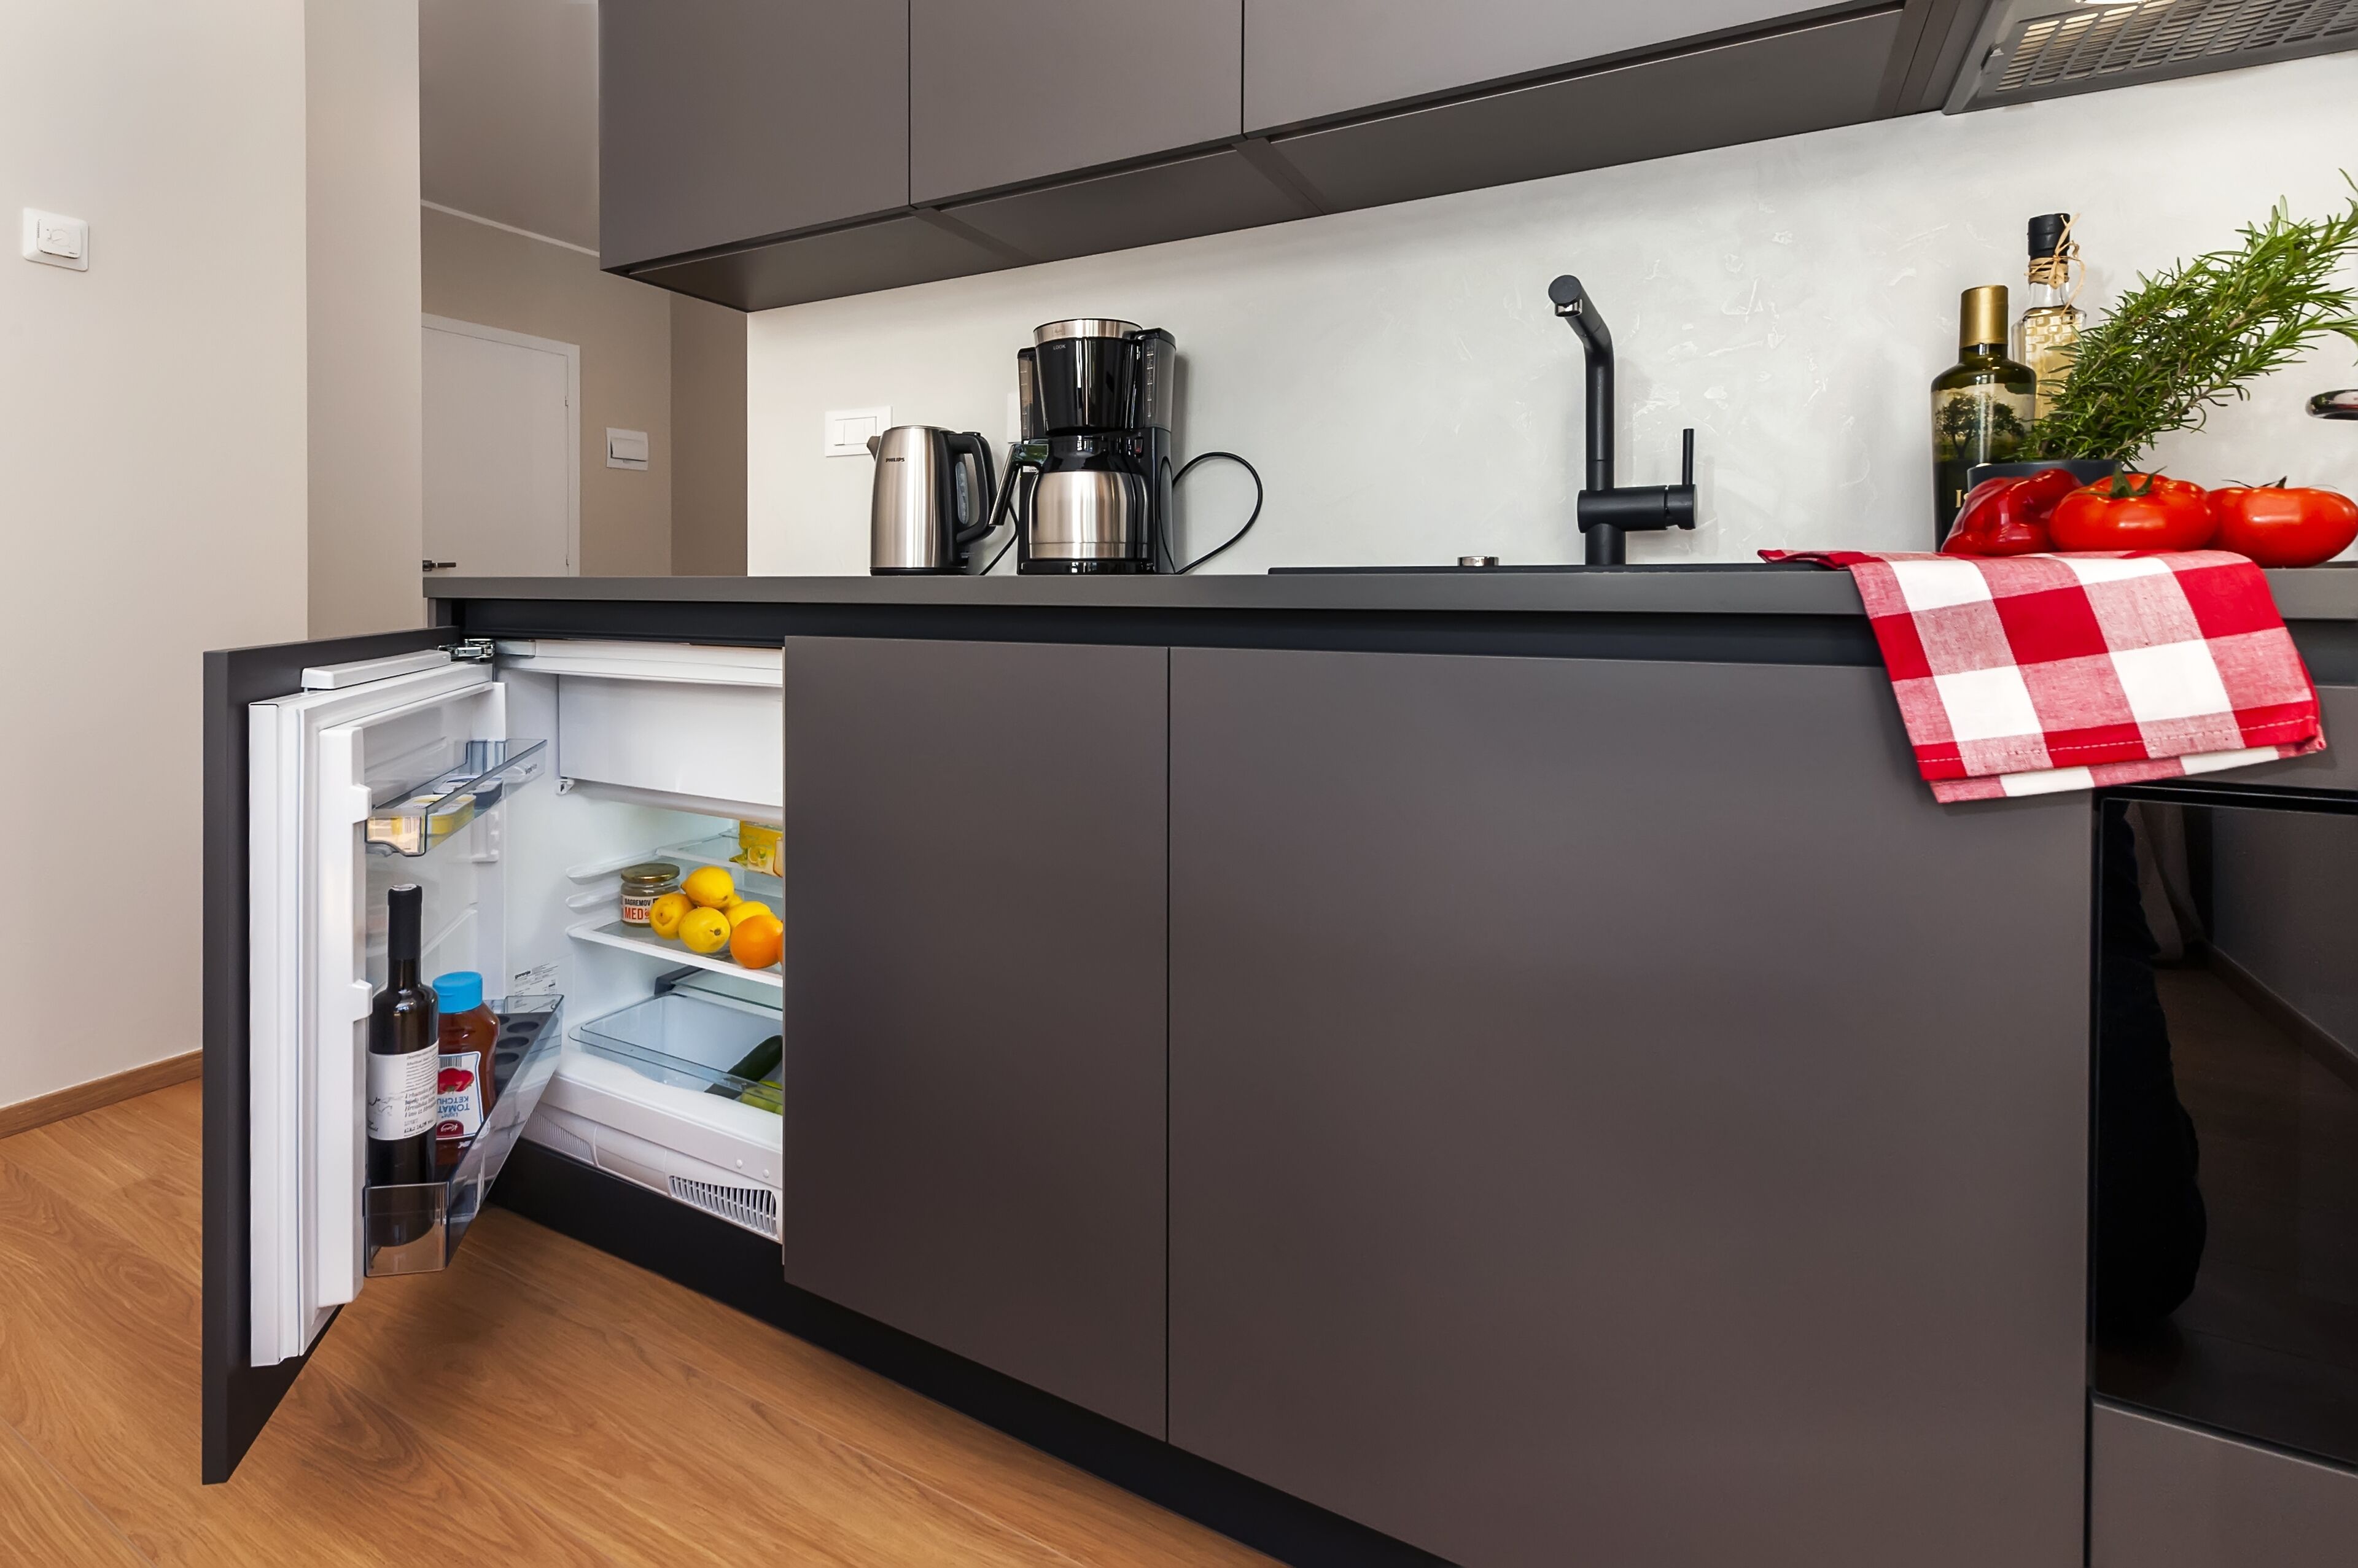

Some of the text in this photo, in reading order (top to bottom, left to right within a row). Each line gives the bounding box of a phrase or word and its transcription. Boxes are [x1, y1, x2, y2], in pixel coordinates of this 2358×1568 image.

[625, 907, 644, 920] MED
[437, 1096, 469, 1104] KETCHU
[437, 1103, 470, 1114] TOMAT
